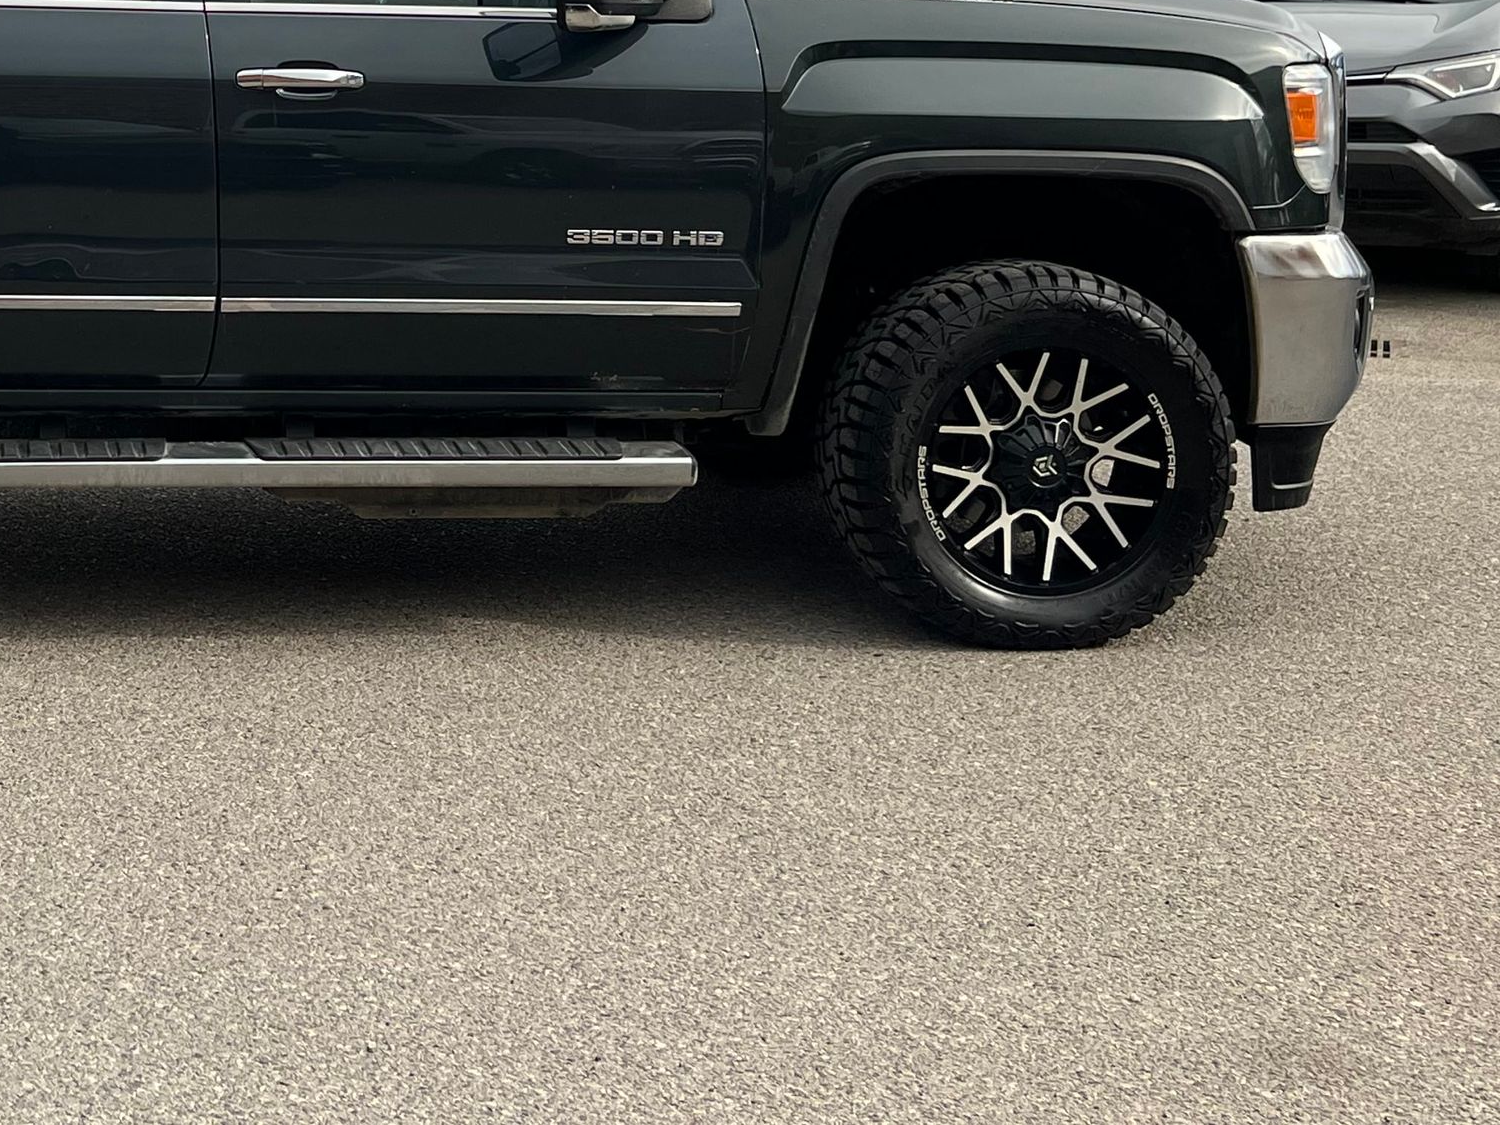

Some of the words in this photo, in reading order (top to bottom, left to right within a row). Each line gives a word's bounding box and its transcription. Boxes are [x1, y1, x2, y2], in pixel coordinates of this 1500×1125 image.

[566, 228, 664, 245] 3500
[672, 230, 725, 246] HD
[1147, 392, 1177, 489] DROPSTARS
[916, 445, 946, 542] DROPSTARS
